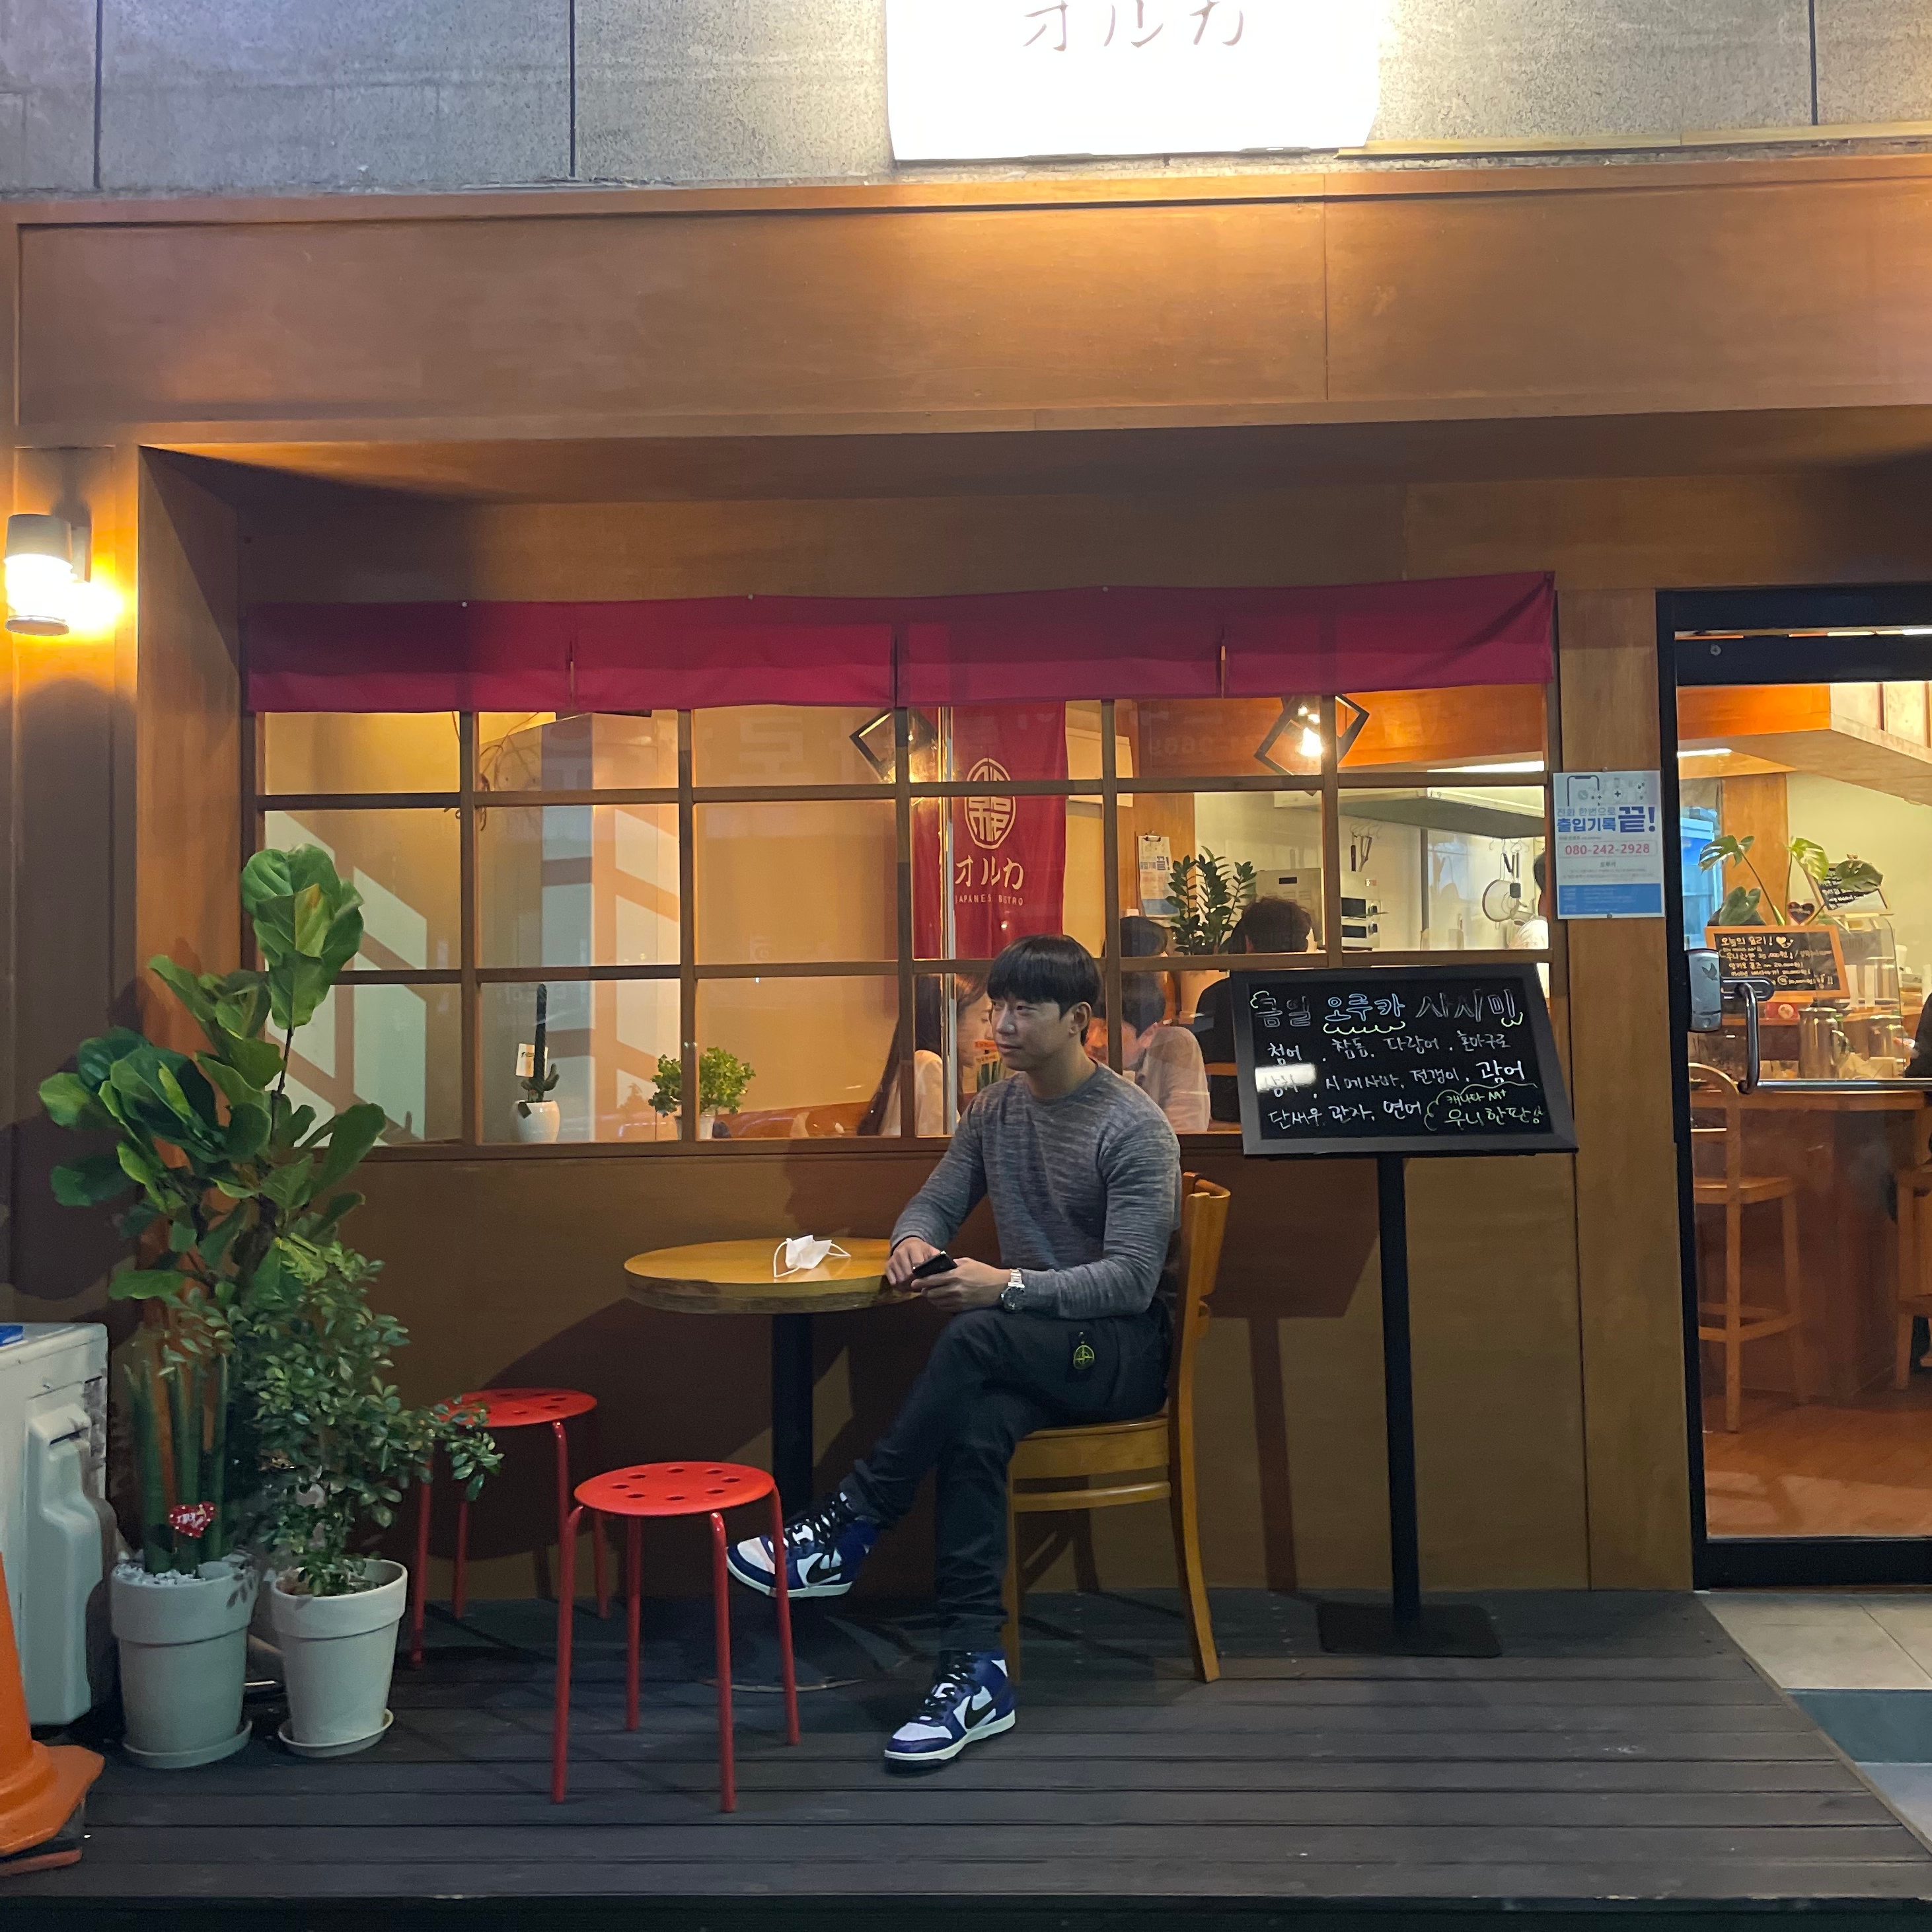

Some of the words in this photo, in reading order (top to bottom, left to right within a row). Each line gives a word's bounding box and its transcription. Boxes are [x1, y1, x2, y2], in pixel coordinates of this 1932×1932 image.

[1023, 0, 1244, 51] オルカ
[1557, 817, 1617, 833] 출입기록
[1618, 806, 1656, 833] 끝!
[1565, 843, 1650, 855] 080-242-2928
[955, 854, 1024, 890] オルカ
[1324, 993, 1405, 1022] 오루카
[1415, 989, 1515, 1022] 사시미
[1383, 1098, 1422, 1120] 연어
